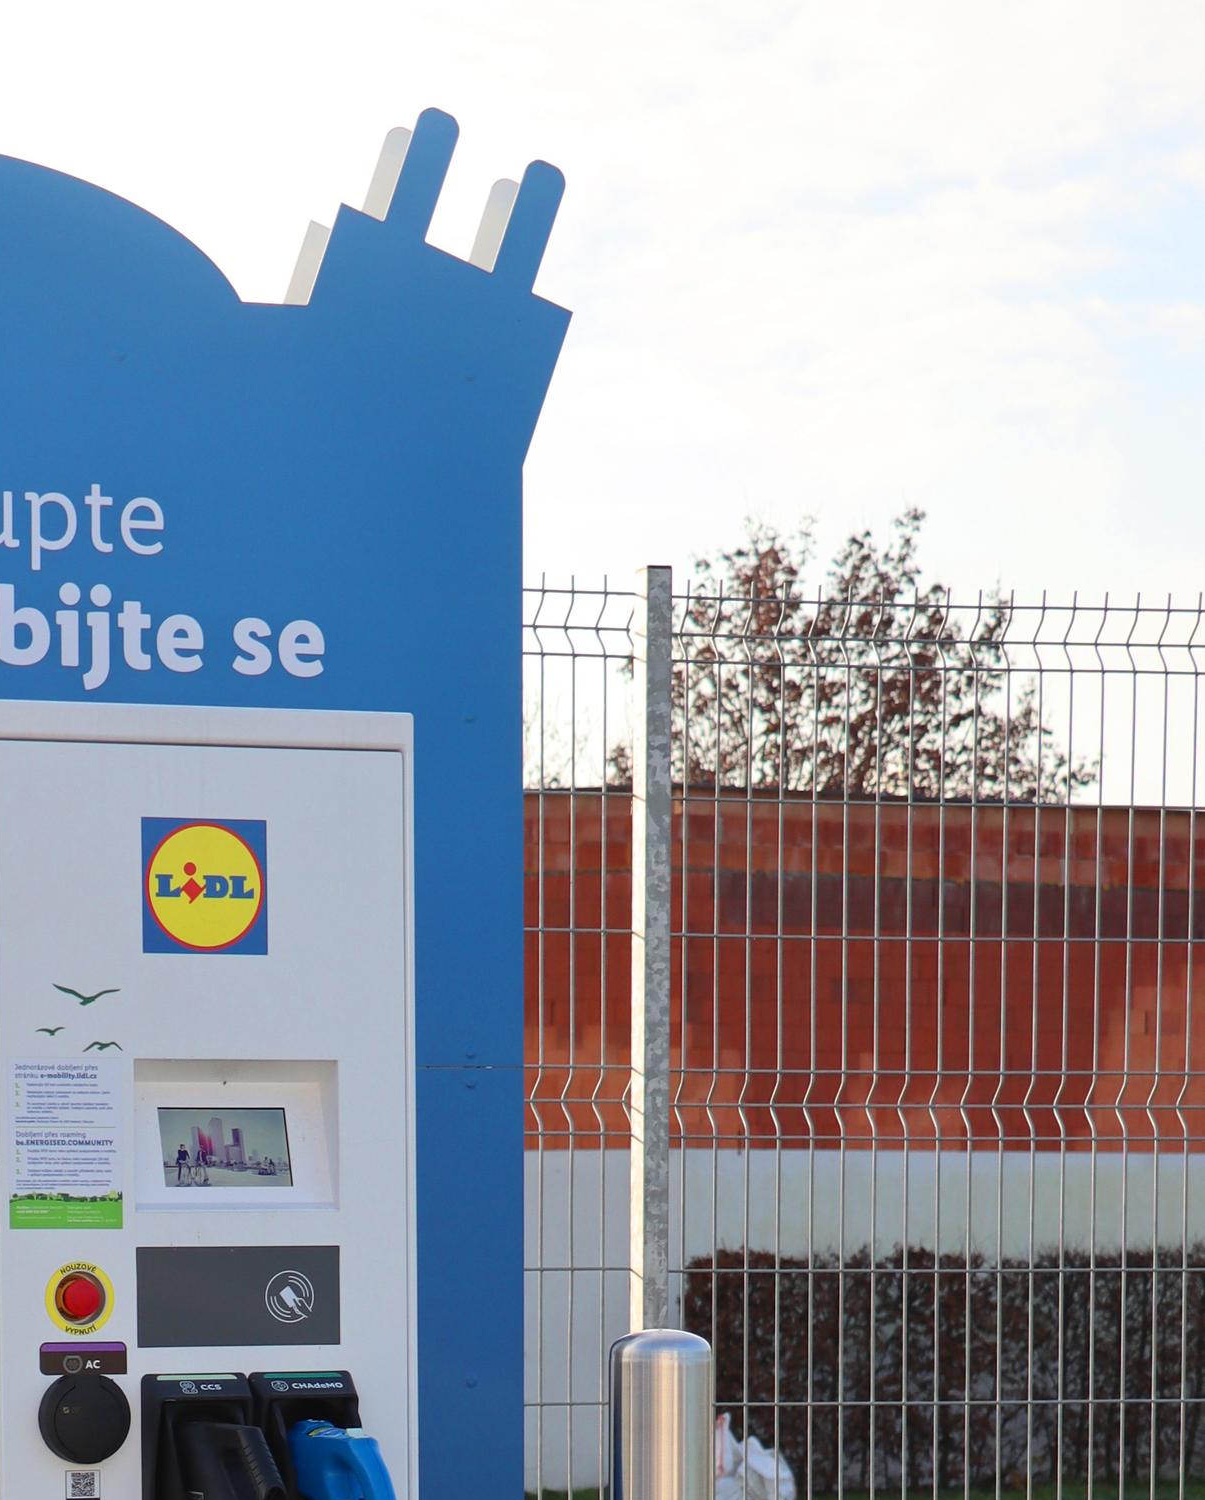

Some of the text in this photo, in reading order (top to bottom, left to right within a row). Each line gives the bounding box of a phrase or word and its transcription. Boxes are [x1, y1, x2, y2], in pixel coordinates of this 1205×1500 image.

[231, 617, 326, 679] se
[60, 1131, 87, 1139] roaming
[59, 1263, 97, 1275] NOUZOVÉ
[65, 1324, 97, 1336] VYPNUTÍ
[85, 1359, 101, 1369] AC
[291, 1382, 344, 1390] CHAdeMO
